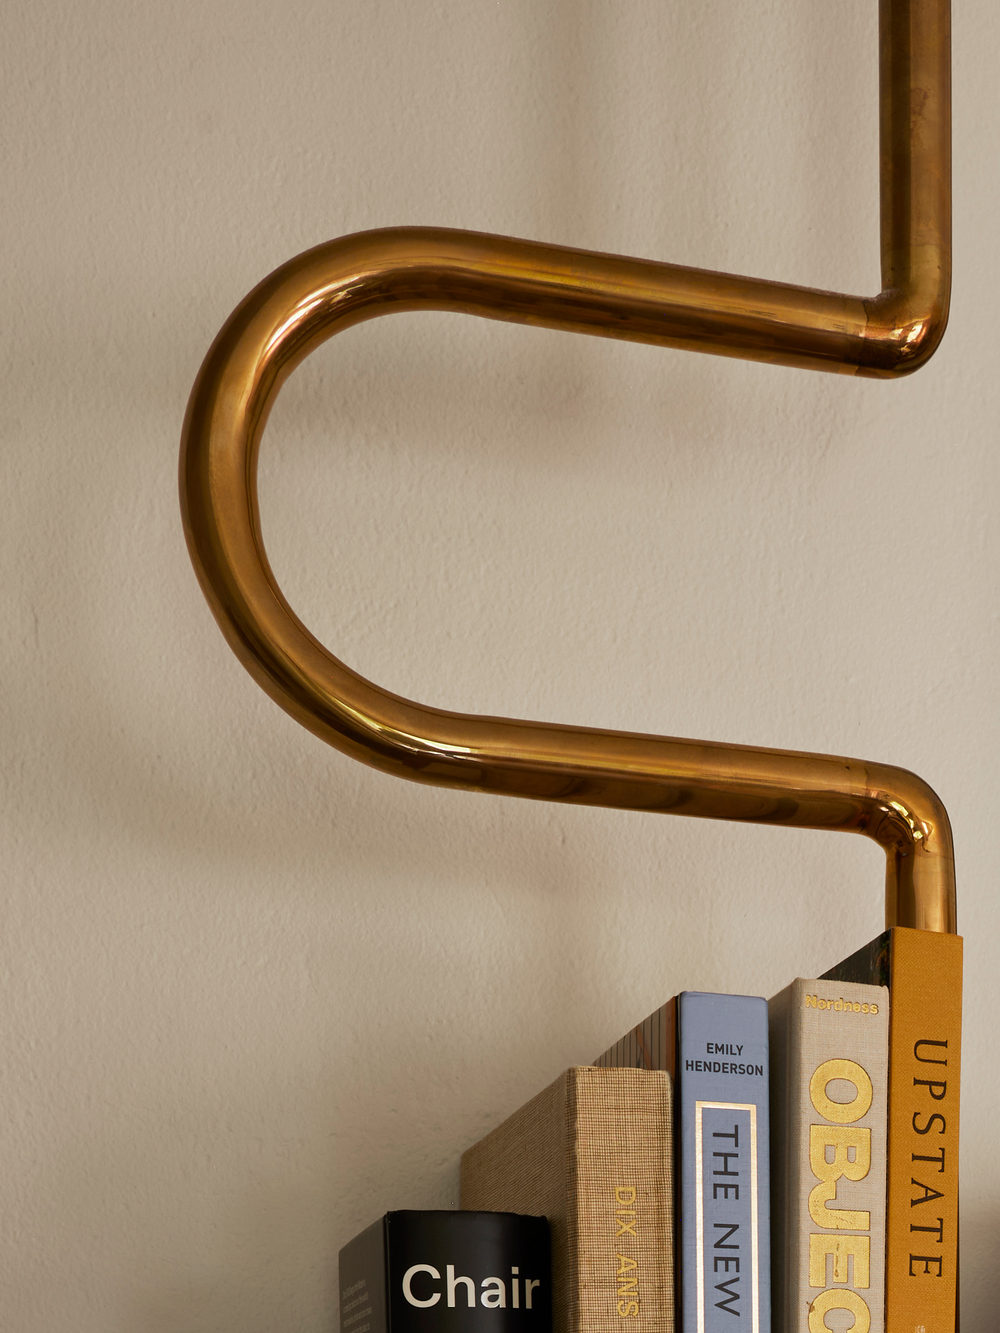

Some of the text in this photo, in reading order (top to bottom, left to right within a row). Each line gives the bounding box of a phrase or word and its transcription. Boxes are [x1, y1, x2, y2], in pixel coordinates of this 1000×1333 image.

[805, 994, 879, 1015] Nordness
[685, 1060, 763, 1076] HENDERSON
[706, 1042, 744, 1056] EMILY
[712, 1124, 740, 1200] THE
[909, 1039, 948, 1277] UPSTATE
[614, 1186, 637, 1237] DIX
[402, 1263, 541, 1309] Chair
[616, 1253, 639, 1317] ANS
[713, 1223, 741, 1317] NEW
